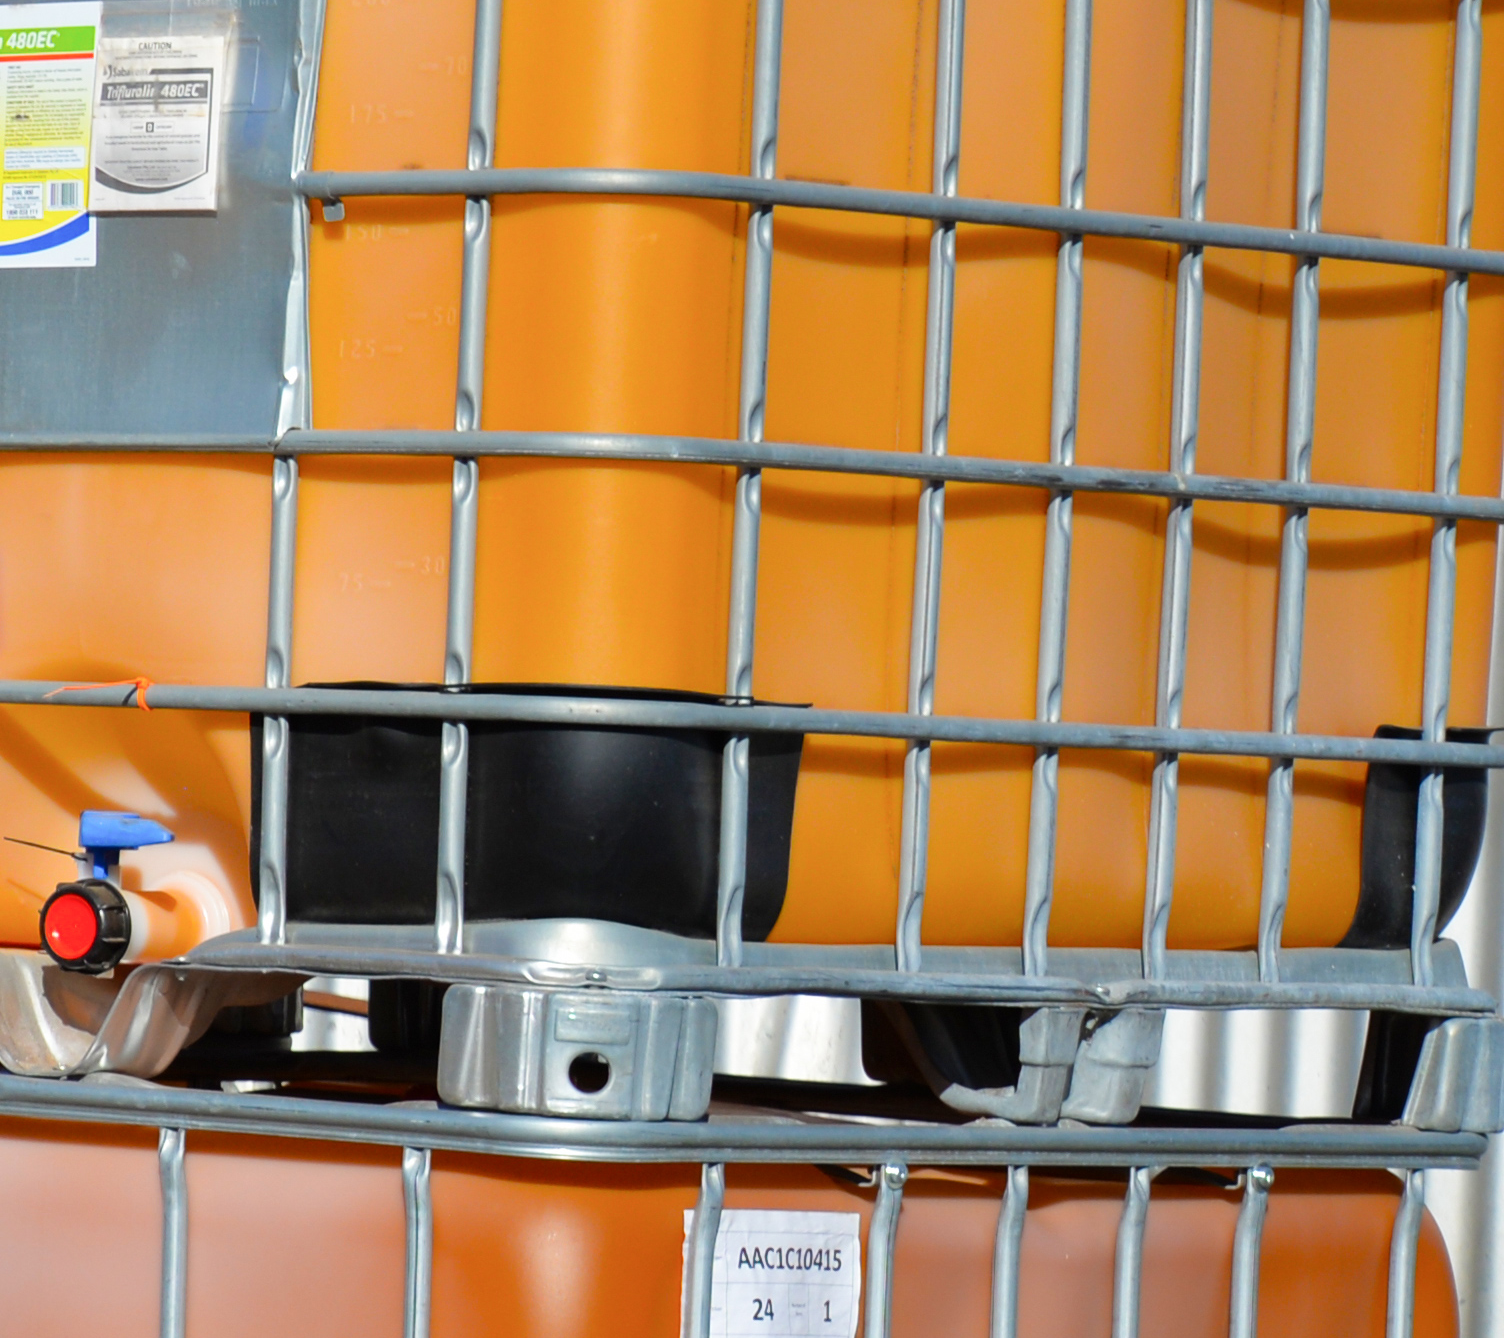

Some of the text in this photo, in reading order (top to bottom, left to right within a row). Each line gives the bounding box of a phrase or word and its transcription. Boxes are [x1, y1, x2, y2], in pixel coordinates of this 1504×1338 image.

[138, 42, 172, 51] CAUTION
[738, 1246, 842, 1271] AAC1C10415
[752, 1298, 832, 1322] 24 1
